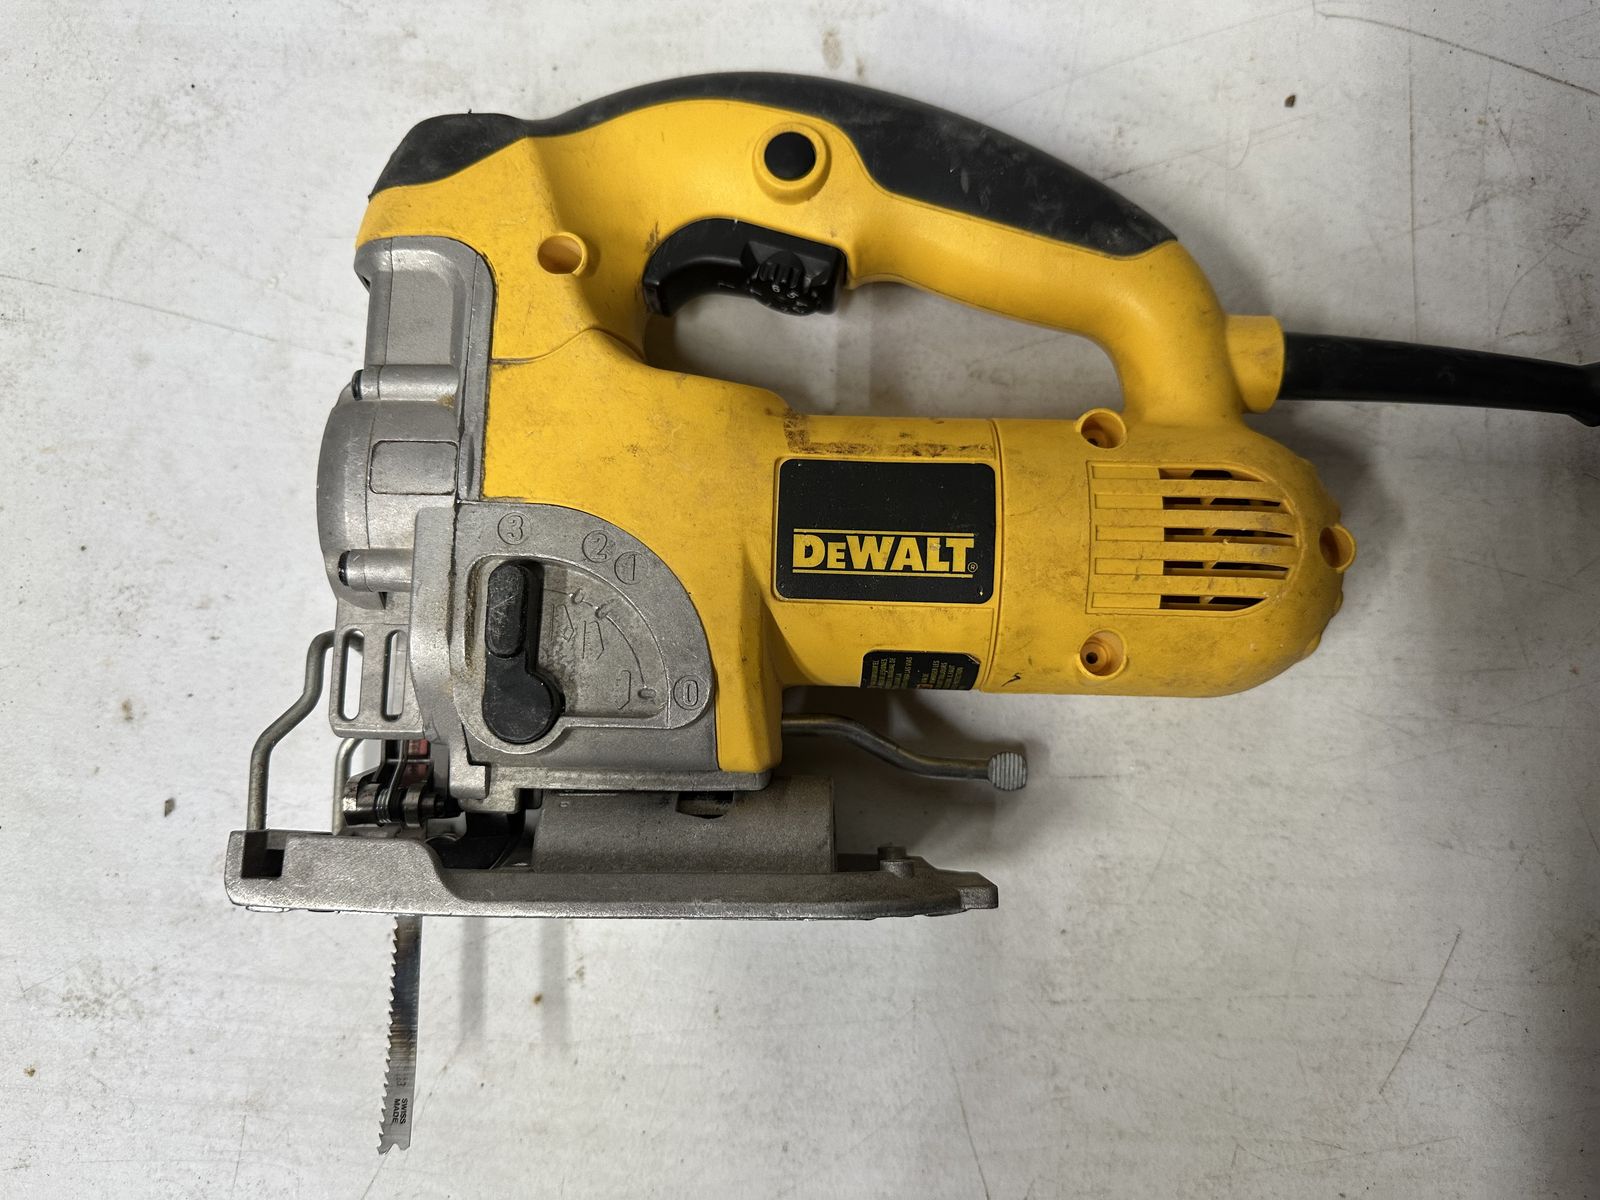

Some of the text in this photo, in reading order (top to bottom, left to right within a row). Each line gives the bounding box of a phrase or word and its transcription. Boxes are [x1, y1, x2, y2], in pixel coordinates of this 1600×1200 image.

[792, 533, 975, 573] DEWALT
[392, 1098, 401, 1124] MADE
[399, 1097, 408, 1125] SWISS
